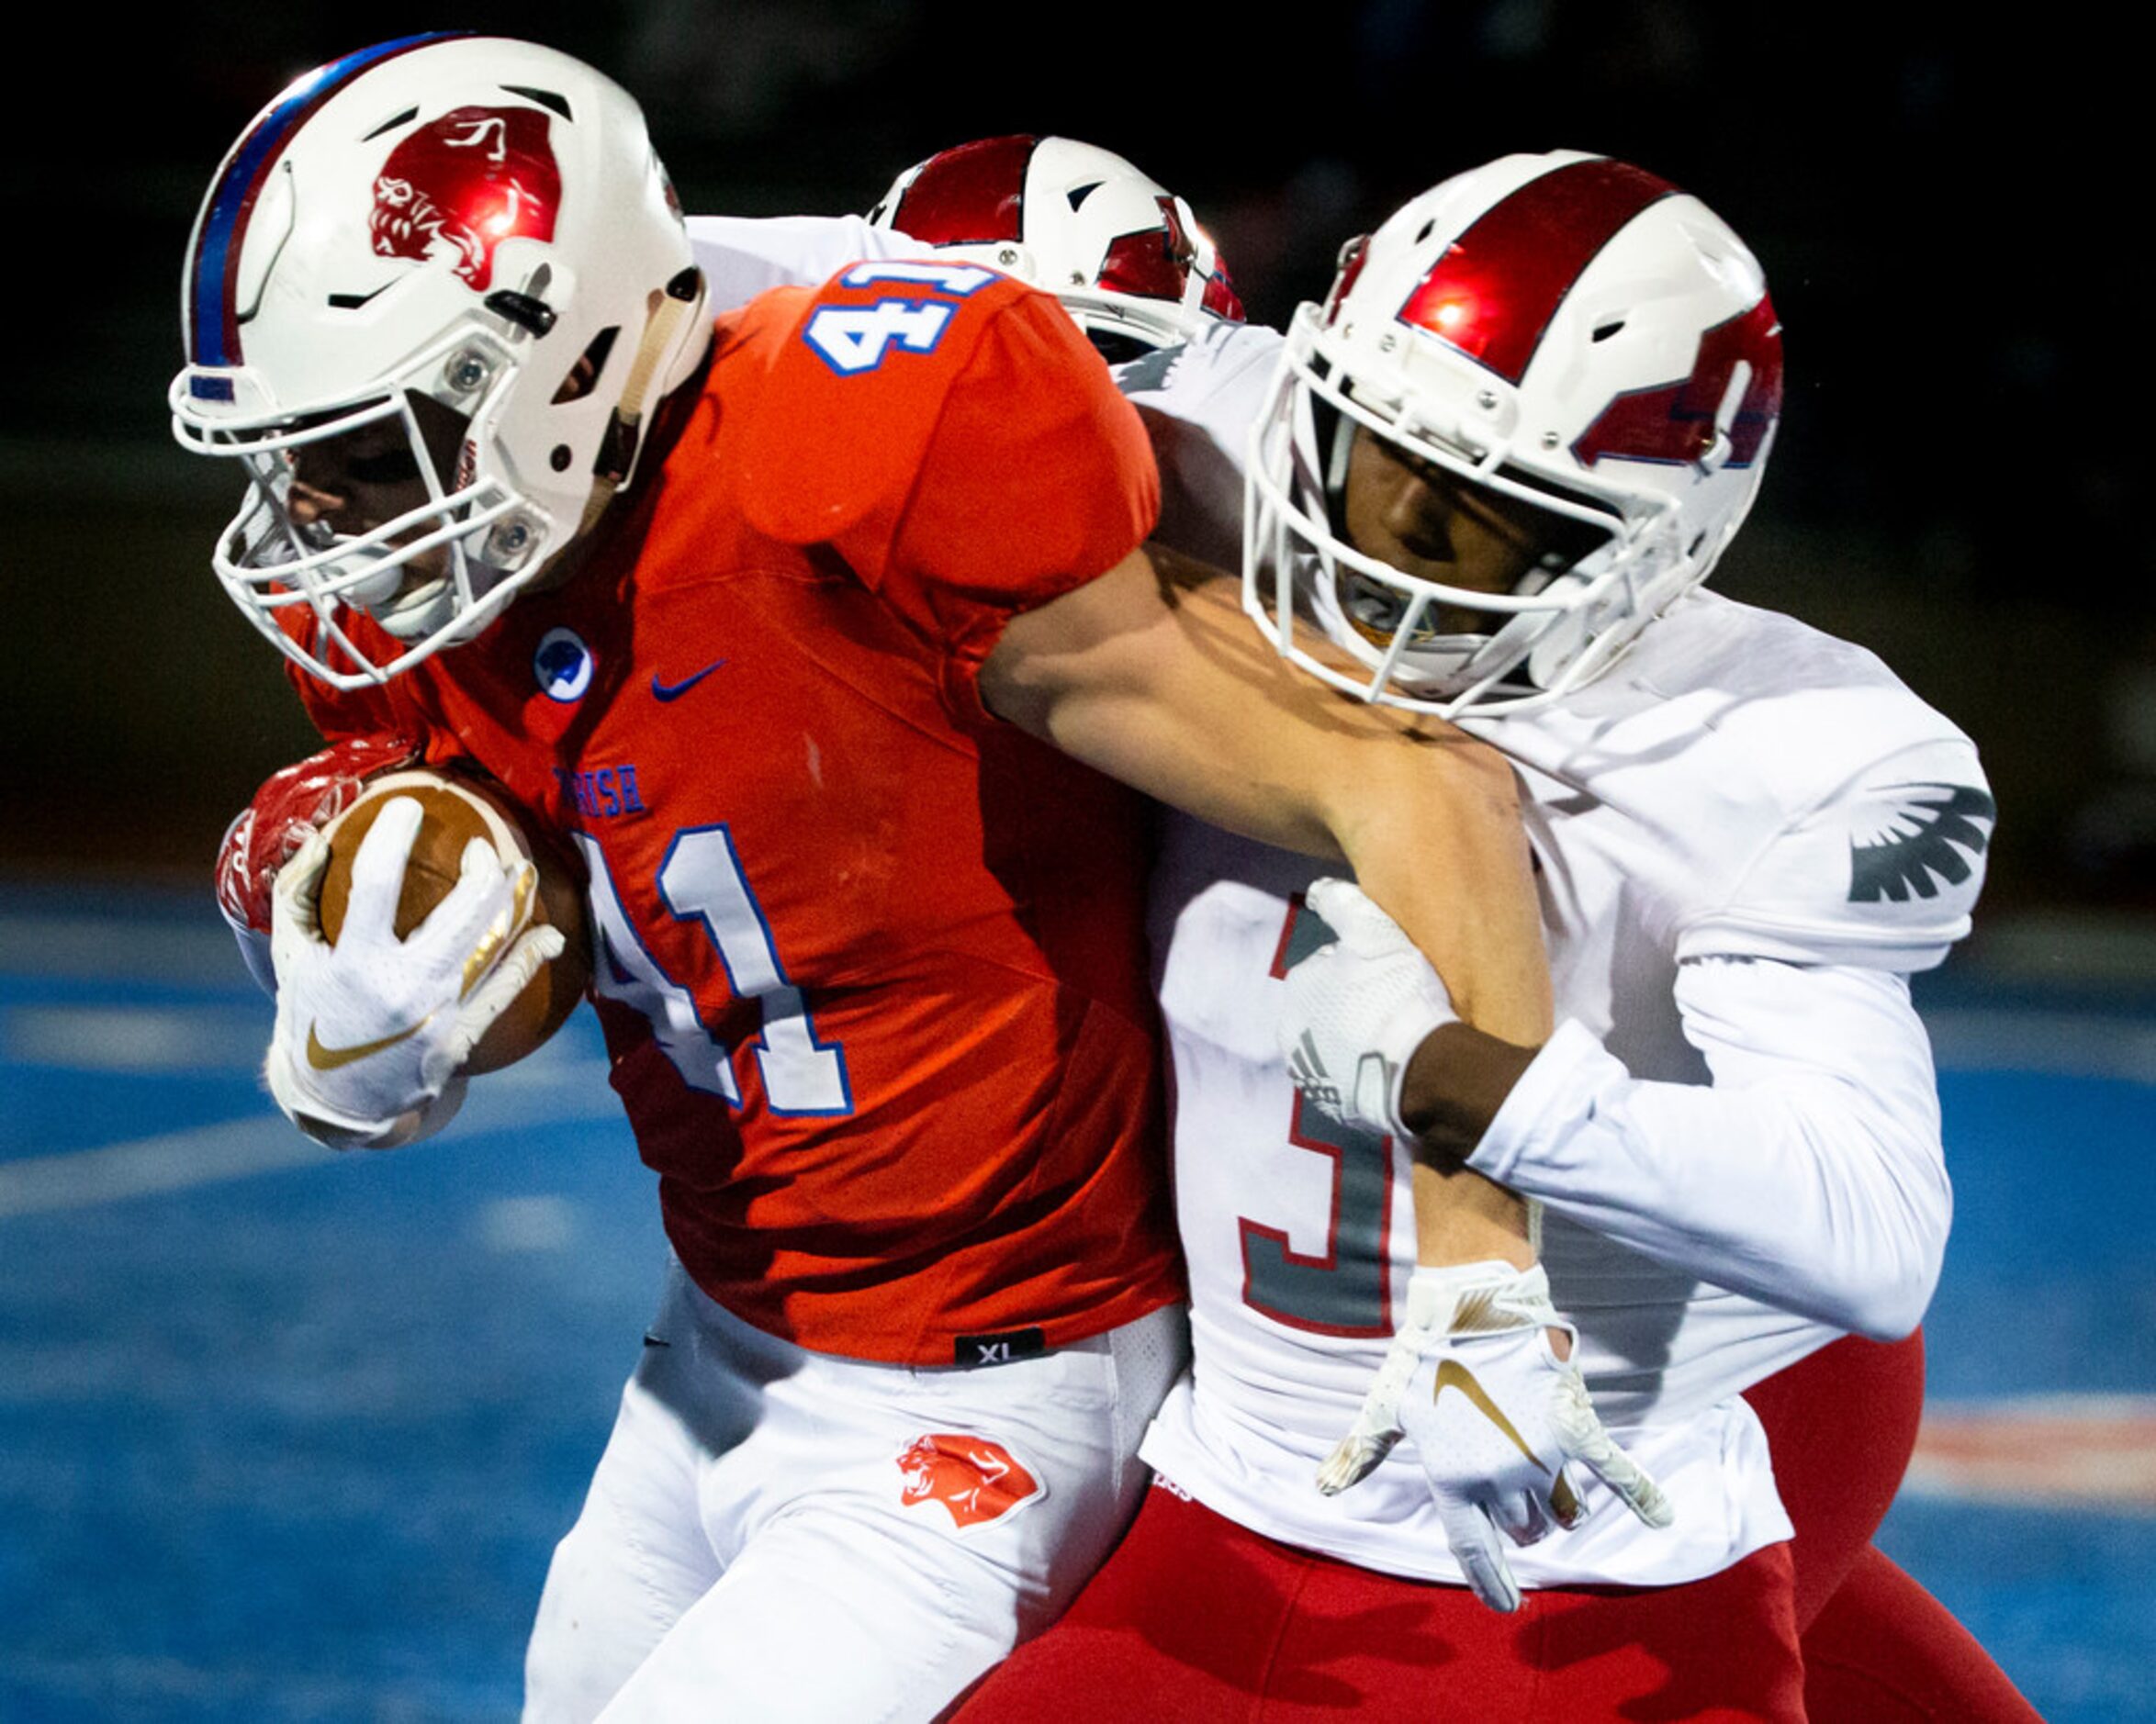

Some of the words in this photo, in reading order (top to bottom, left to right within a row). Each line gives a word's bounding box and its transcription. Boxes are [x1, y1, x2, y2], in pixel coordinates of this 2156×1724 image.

[802, 261, 1007, 377] 41
[571, 823, 855, 1117] 41
[1238, 891, 1395, 1338] 3
